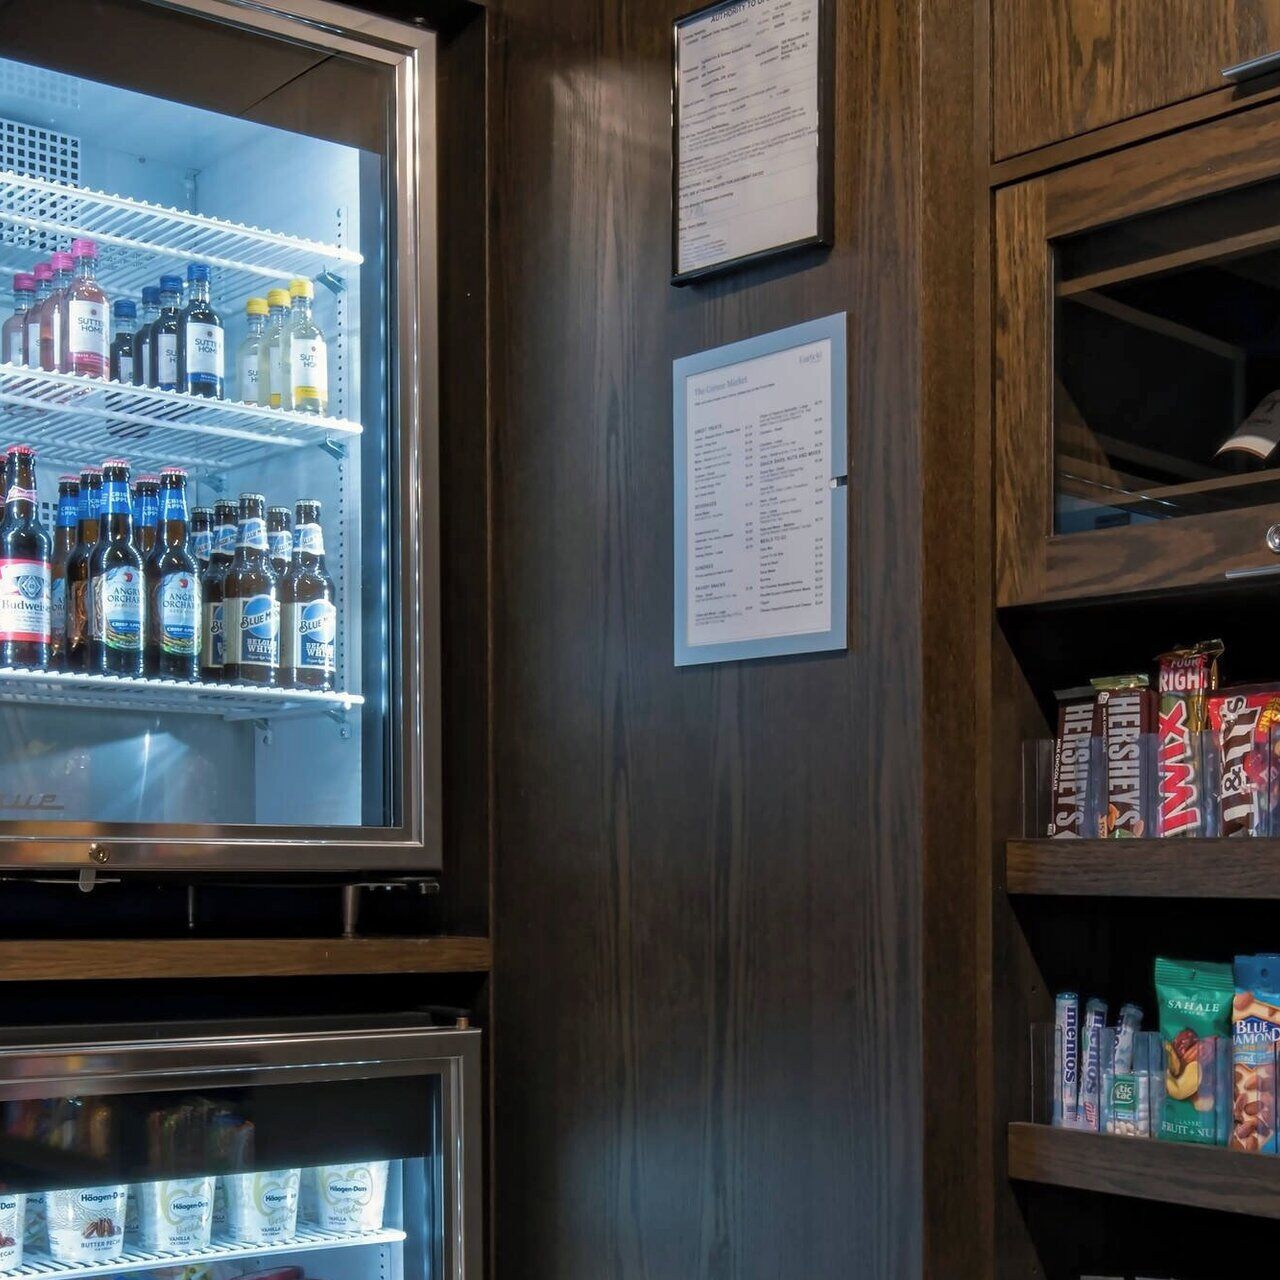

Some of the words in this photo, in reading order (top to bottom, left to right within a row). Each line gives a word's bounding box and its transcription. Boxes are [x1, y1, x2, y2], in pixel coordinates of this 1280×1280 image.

[107, 595, 141, 604] ORCHA
[1055, 704, 1094, 826] HERSHEY'S
[1107, 695, 1141, 826] HERSHEY'S
[1168, 999, 1221, 1013] SAHALE
[1236, 1020, 1269, 1034] BLUE
[1065, 1005, 1079, 1084] mentos
[1085, 1010, 1107, 1095] mentos
[1118, 1082, 1133, 1092] tic
[1116, 1091, 1133, 1101] tac
